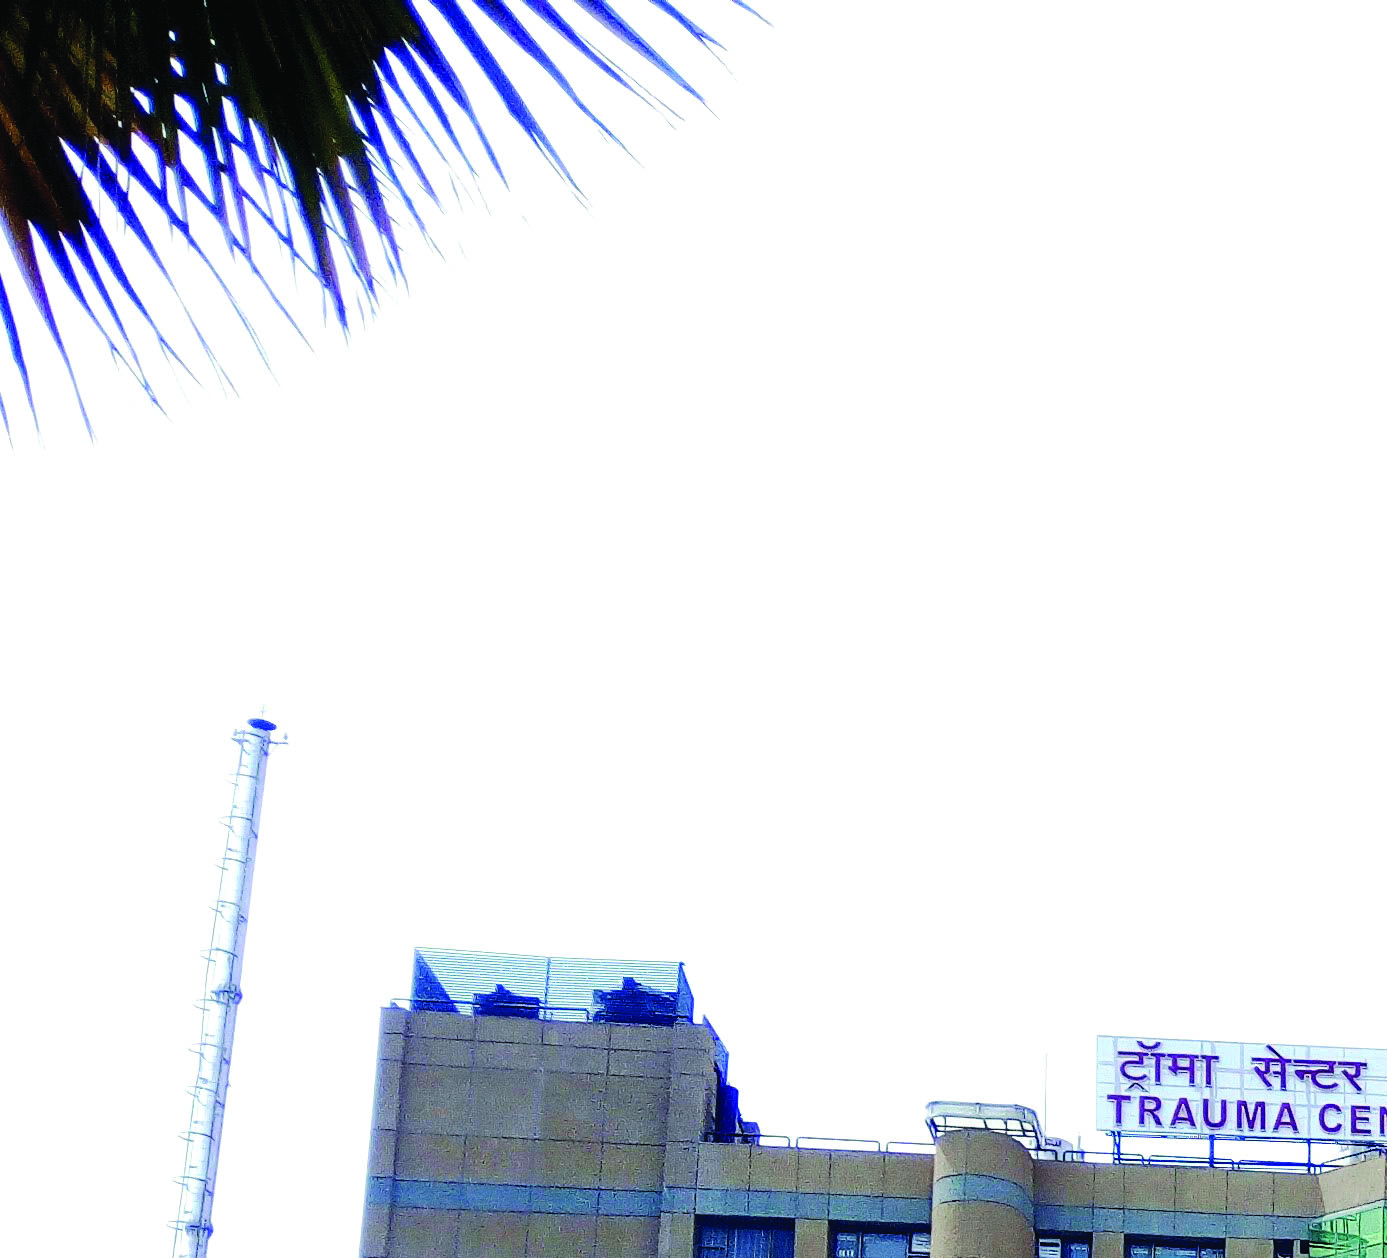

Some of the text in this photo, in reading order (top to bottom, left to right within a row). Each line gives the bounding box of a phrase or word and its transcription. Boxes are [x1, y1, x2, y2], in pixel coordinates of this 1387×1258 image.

[1117, 1040, 1220, 1092] ट्रॉमा
[1252, 1044, 1368, 1093] सेन्टर
[1107, 1094, 1300, 1133] TRAUMA
